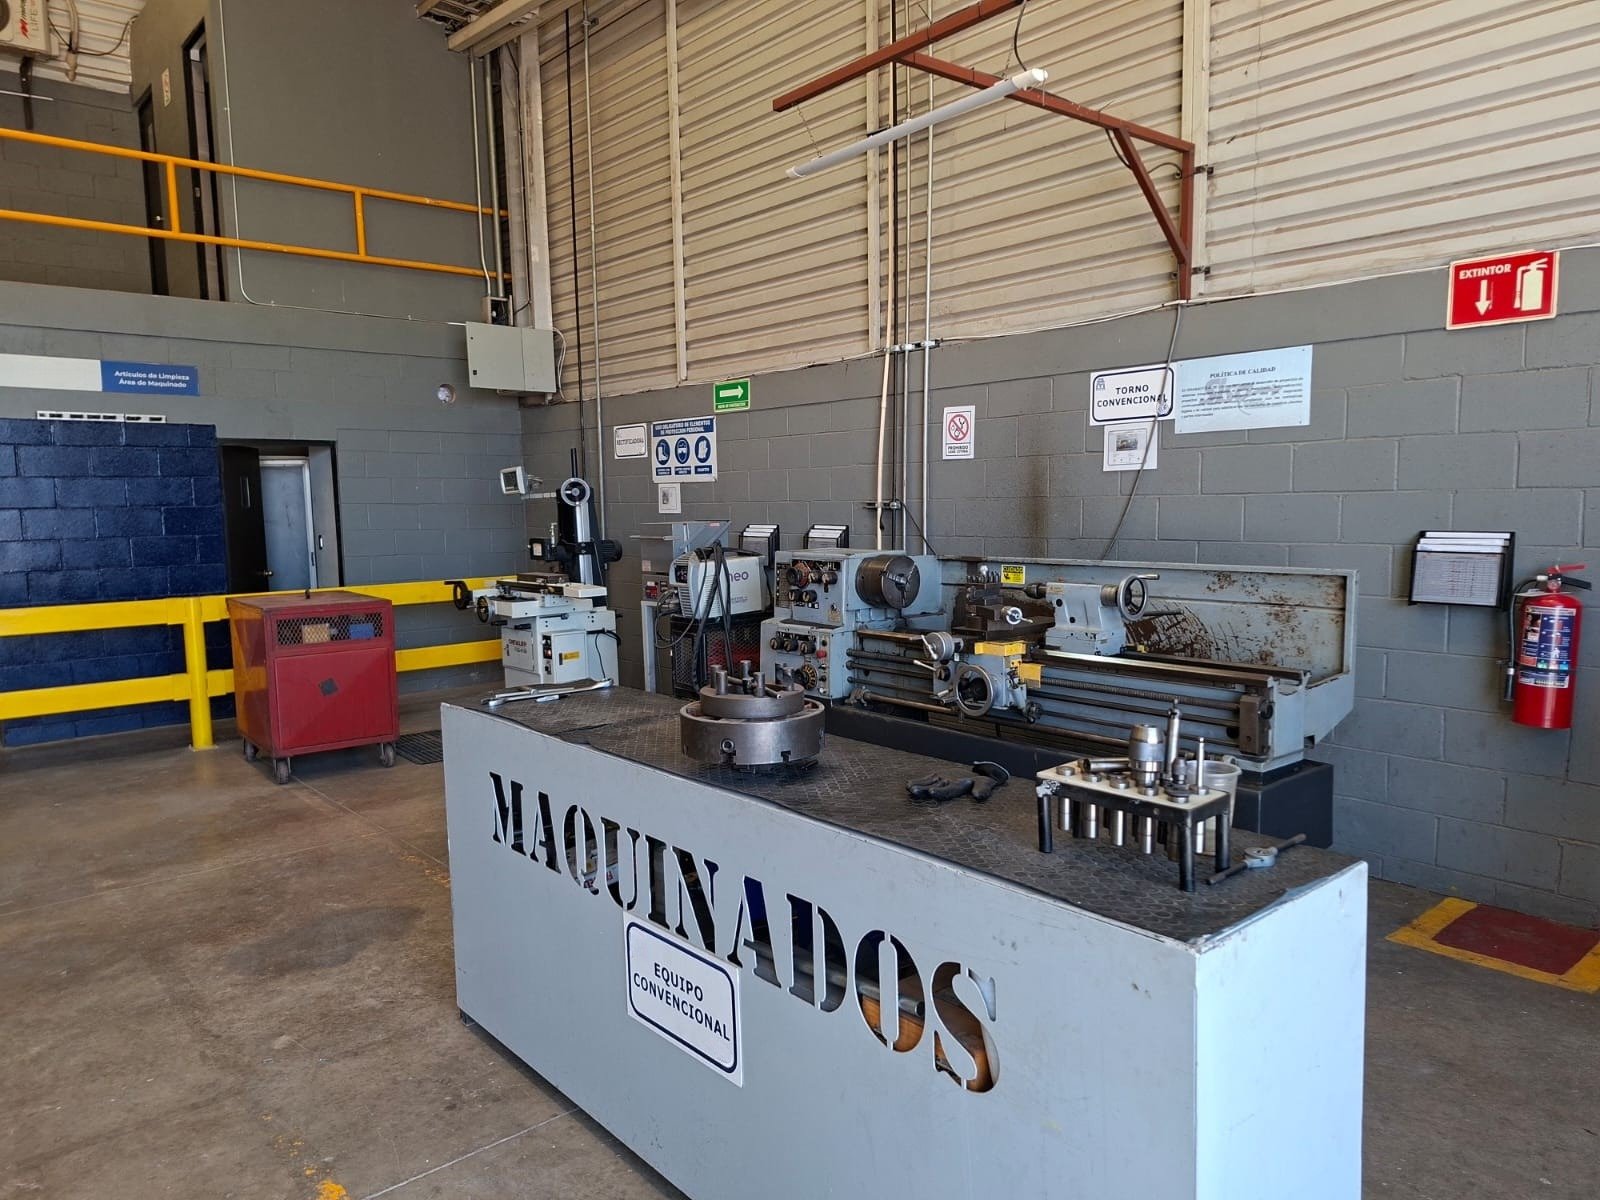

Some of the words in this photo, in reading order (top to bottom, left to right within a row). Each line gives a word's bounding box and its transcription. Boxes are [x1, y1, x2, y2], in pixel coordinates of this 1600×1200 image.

[1459, 264, 1511, 280] EXTINTOR
[148, 371, 157, 379] de
[158, 372, 190, 381] Limpieza
[1248, 366, 1276, 375] CALIDAD
[148, 380, 187, 388] Maquinado
[1116, 384, 1149, 395] TORNO
[489, 771, 1000, 1094] MAQUINADOS
[654, 962, 703, 1002] EQUIPO
[633, 972, 731, 1042] CONVENCIONAL
